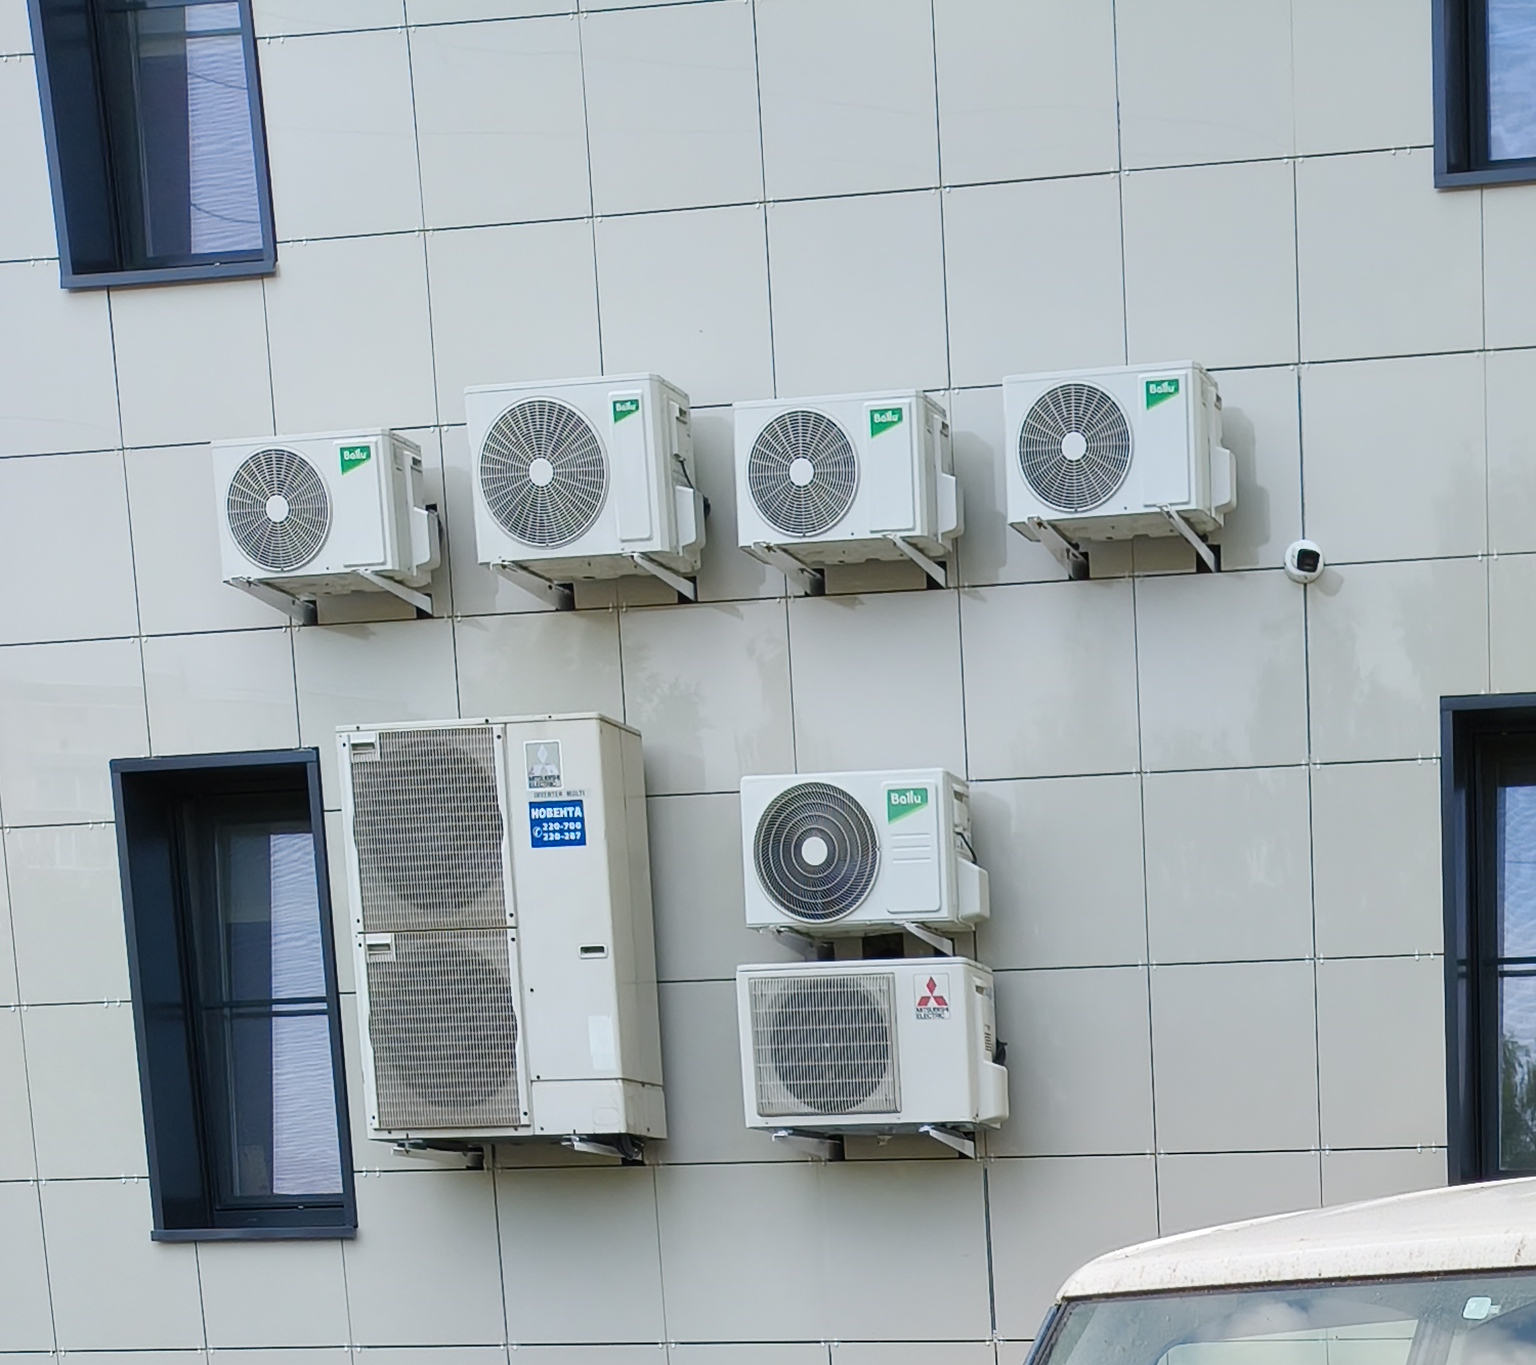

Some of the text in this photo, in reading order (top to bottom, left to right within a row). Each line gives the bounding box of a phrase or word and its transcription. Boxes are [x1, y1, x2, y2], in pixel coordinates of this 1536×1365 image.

[343, 448, 367, 460] Ballu
[891, 790, 922, 805] Ballu
[531, 807, 583, 819] НОВЕНТА
[542, 822, 582, 831] 220-700
